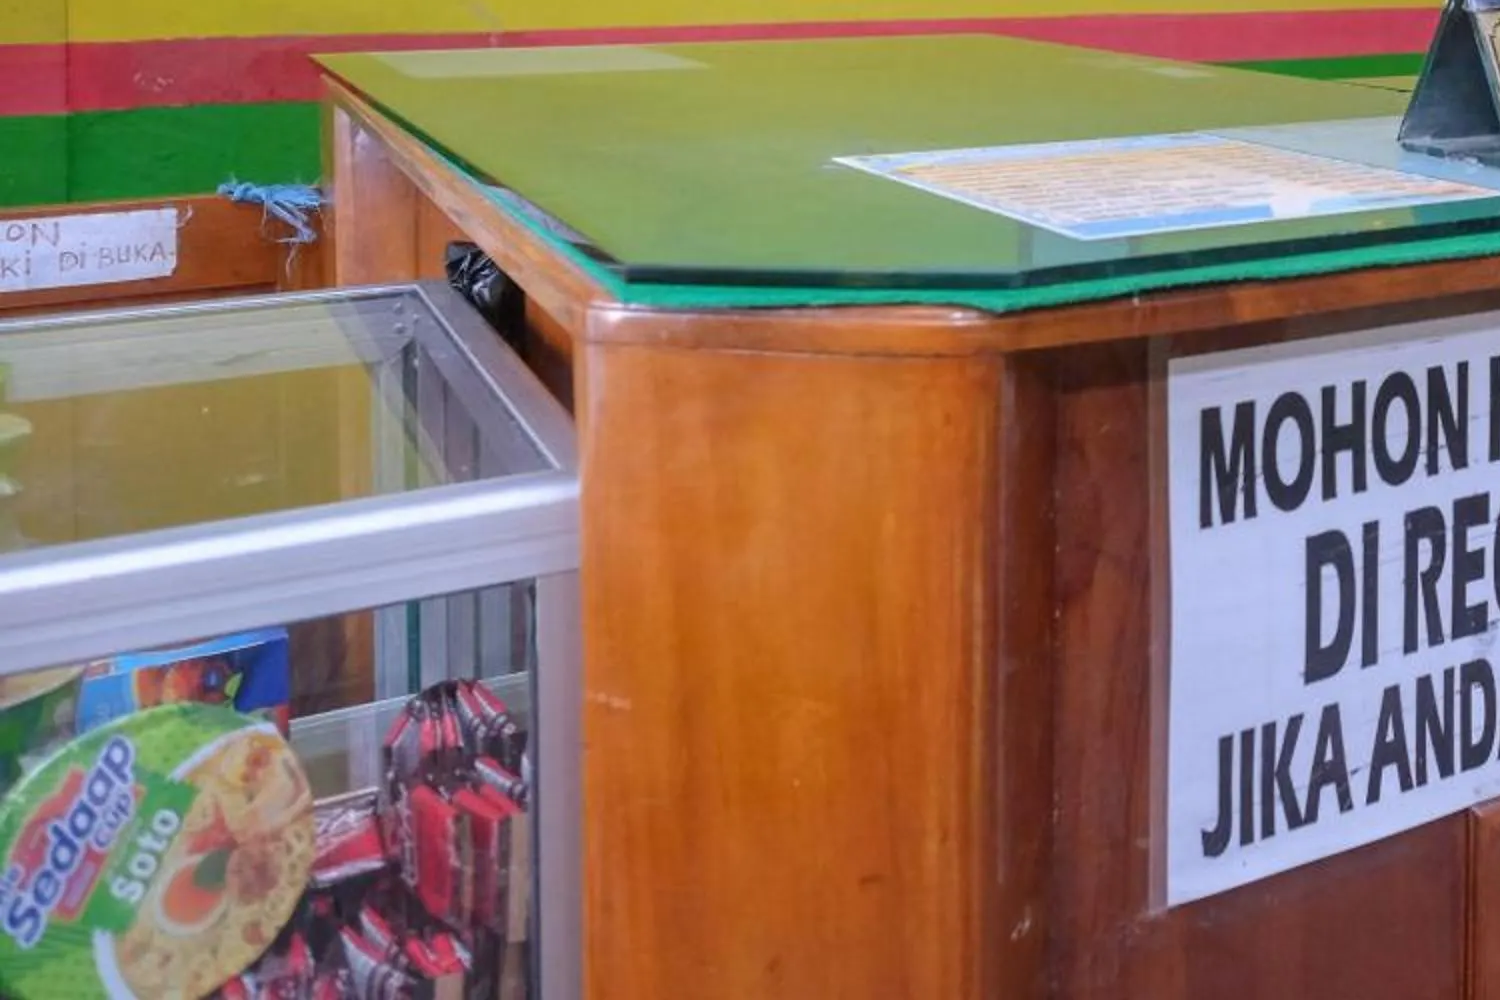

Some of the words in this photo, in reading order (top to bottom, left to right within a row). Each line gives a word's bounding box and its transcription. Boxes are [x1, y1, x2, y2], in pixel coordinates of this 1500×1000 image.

[1199, 360, 1469, 530] MOHON
[1303, 520, 1380, 685] DI
[6, 736, 131, 944] Sedaap
[108, 807, 181, 904] Soto
[1201, 702, 1354, 859] JIKA
